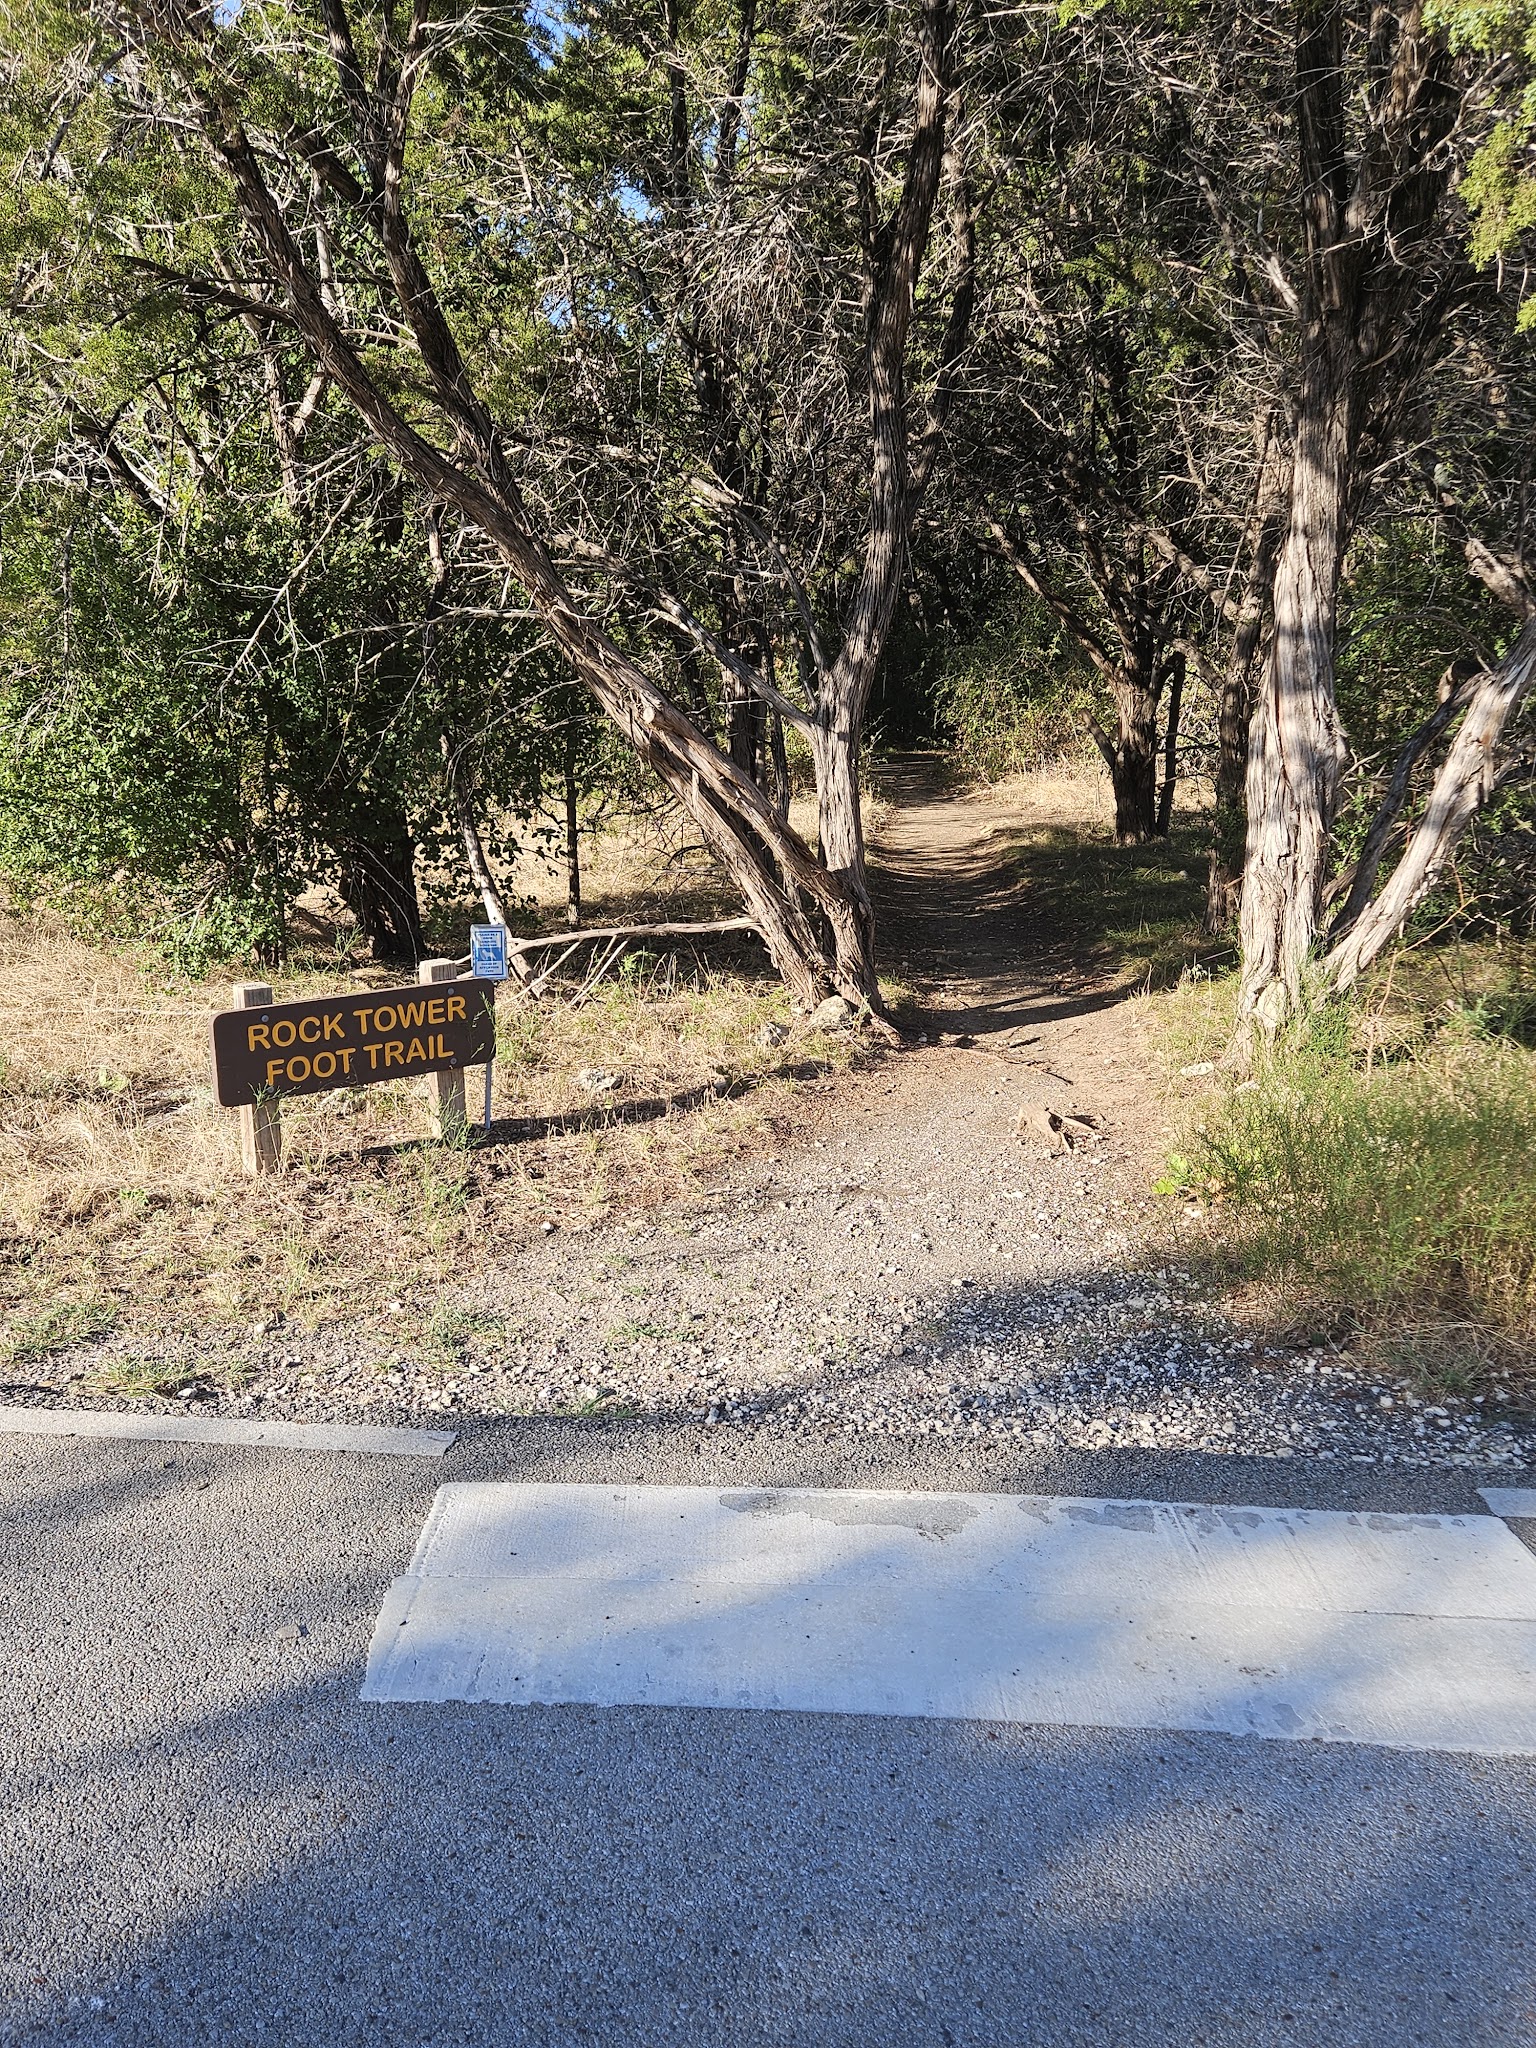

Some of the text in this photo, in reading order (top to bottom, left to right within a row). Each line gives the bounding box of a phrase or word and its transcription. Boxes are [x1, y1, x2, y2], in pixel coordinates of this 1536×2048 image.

[247, 995, 467, 1052] ROCK TOWER
[266, 1033, 454, 1086] FOOT TRAIL
